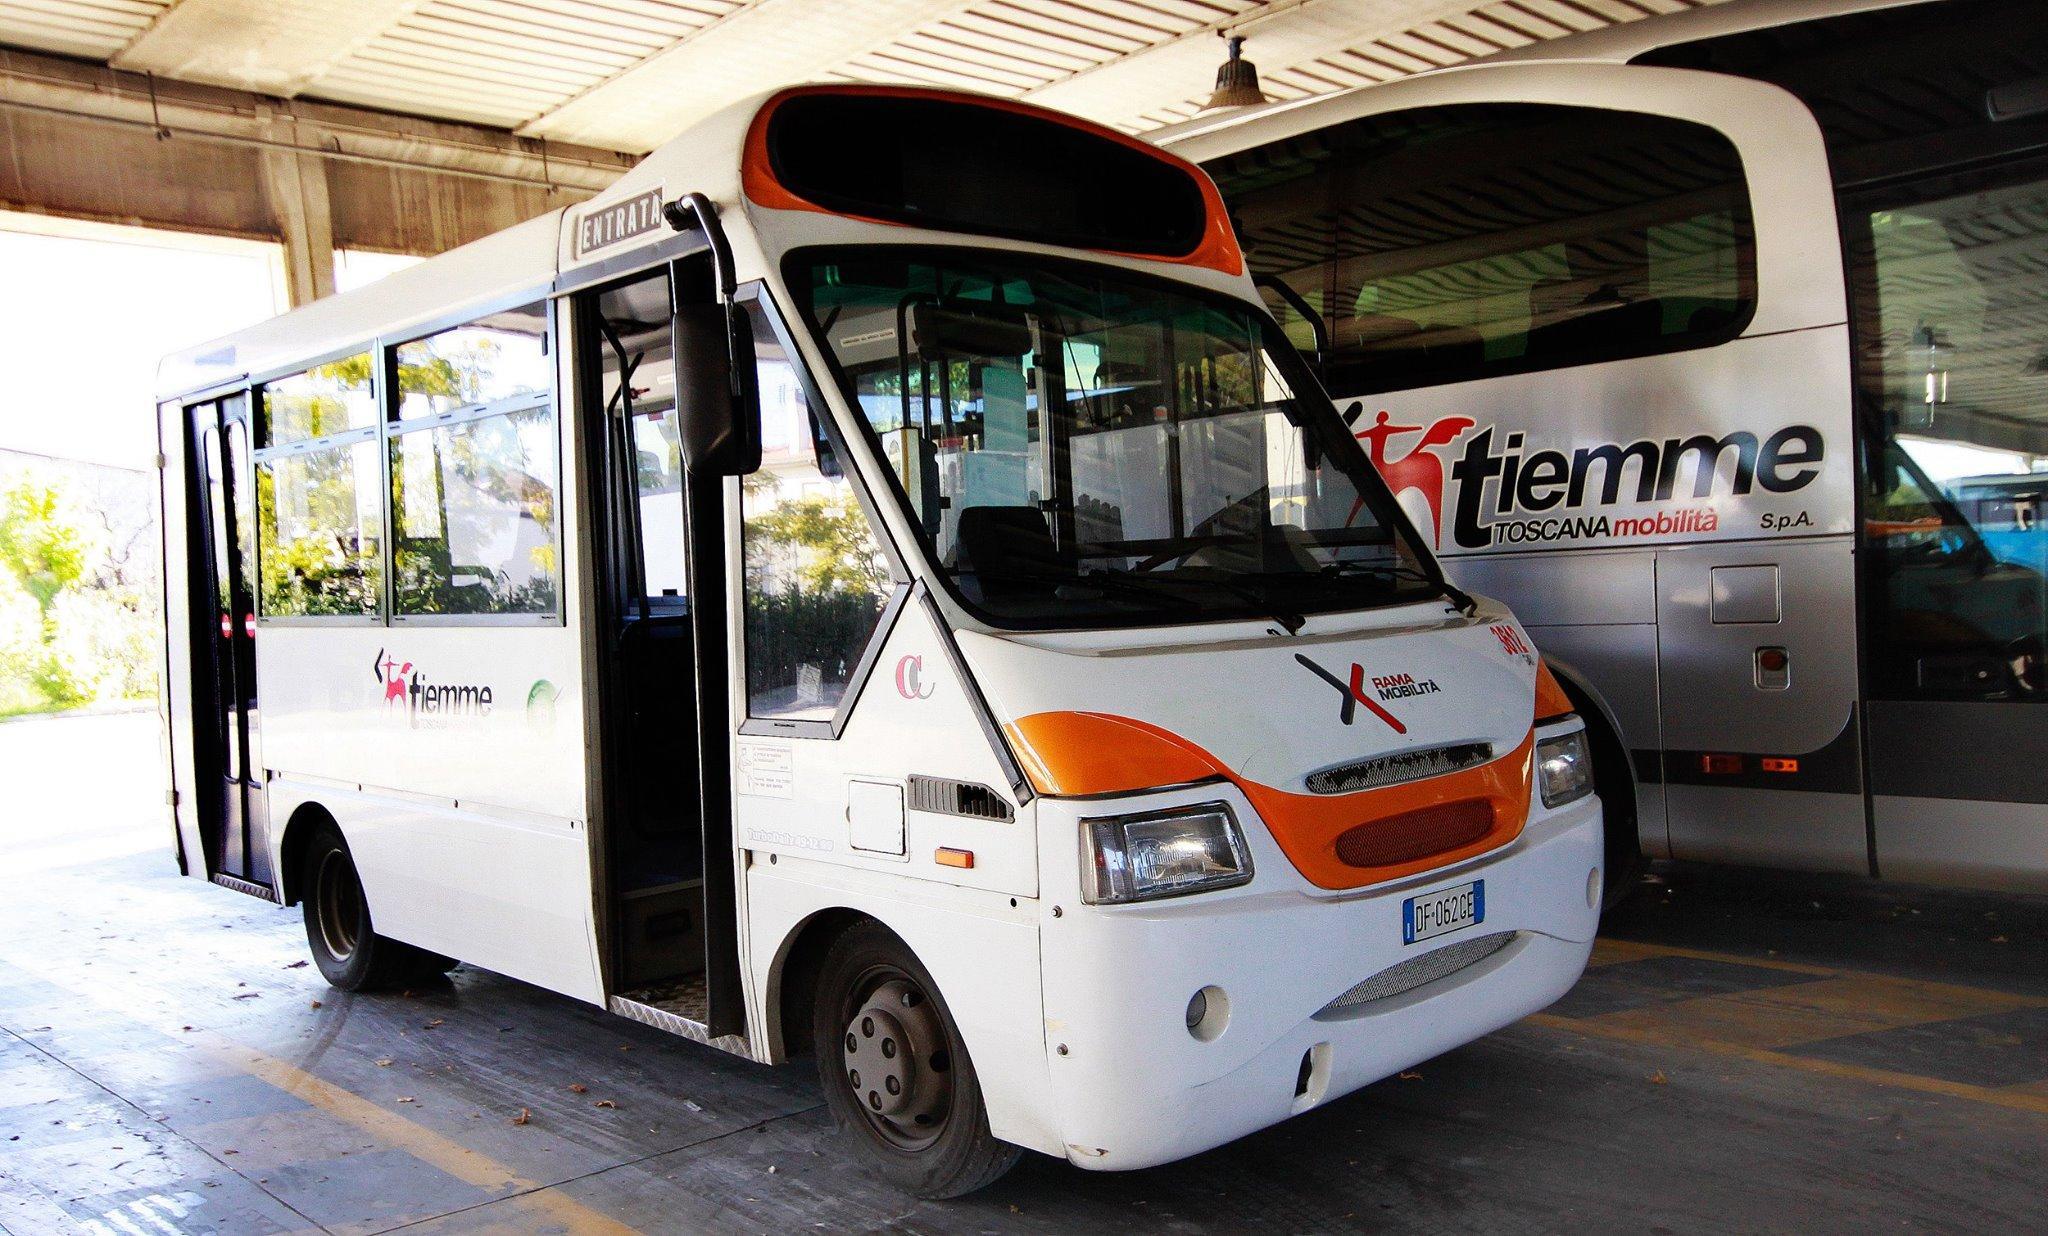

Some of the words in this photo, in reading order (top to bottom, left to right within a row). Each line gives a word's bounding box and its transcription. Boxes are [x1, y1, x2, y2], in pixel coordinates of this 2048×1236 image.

[583, 194, 661, 249] ENTRATA
[1452, 425, 1825, 548] tiemme
[1494, 516, 1611, 543] TOSCANA
[1613, 507, 1718, 537] mobilità
[1761, 511, 1814, 531] S.p.A.
[409, 670, 493, 730] tiemme
[1372, 673, 1415, 689] RAMA
[1378, 679, 1441, 700] MOBILITÀ
